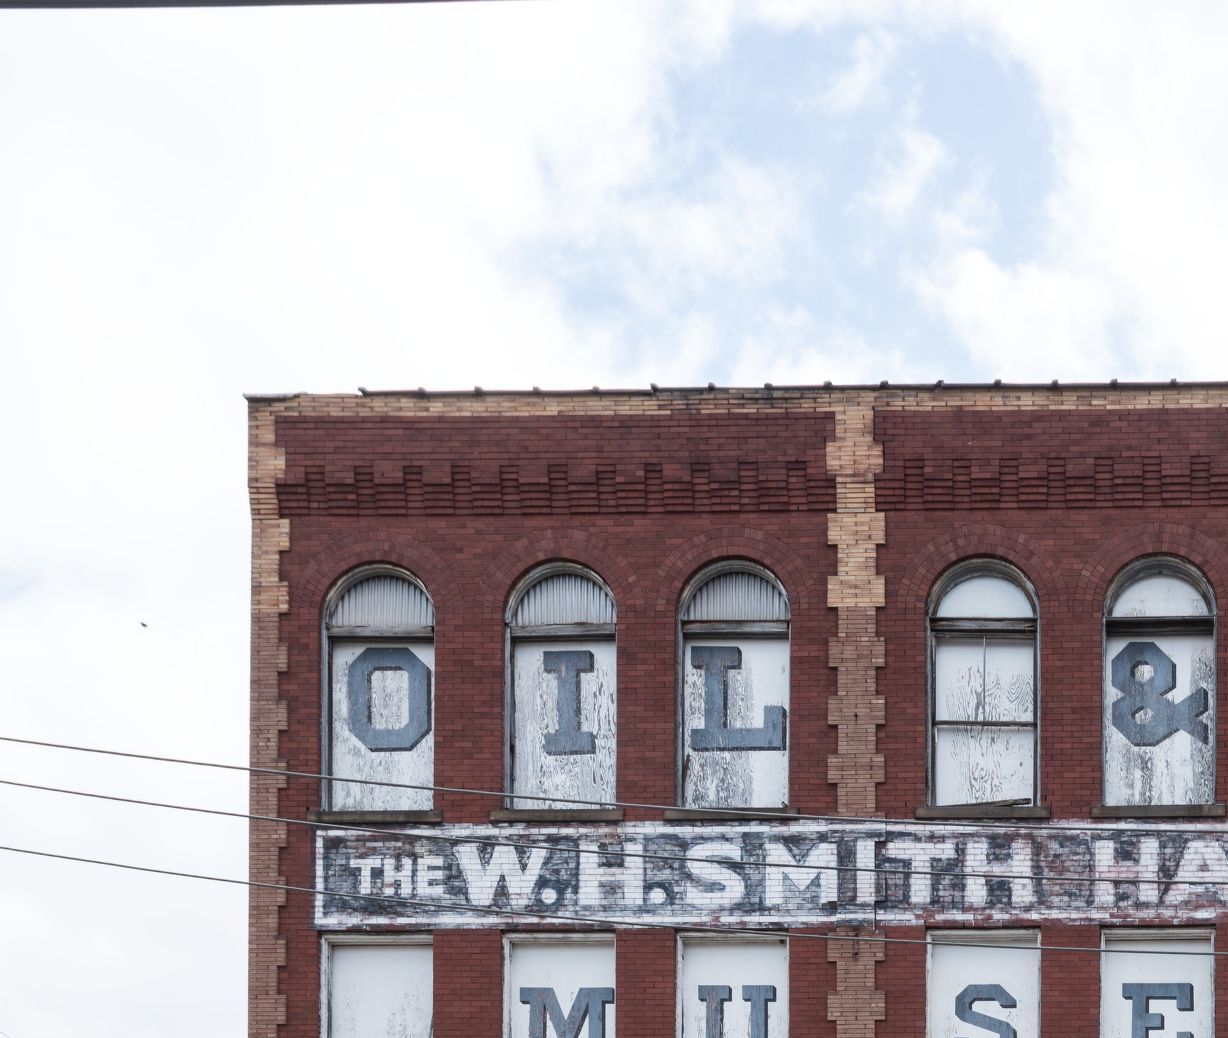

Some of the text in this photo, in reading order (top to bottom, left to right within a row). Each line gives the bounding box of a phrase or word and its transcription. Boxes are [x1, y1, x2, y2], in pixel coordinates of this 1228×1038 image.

[347, 645, 788, 755] OIL
[1110, 641, 1208, 747] &
[350, 857, 458, 898] THE
